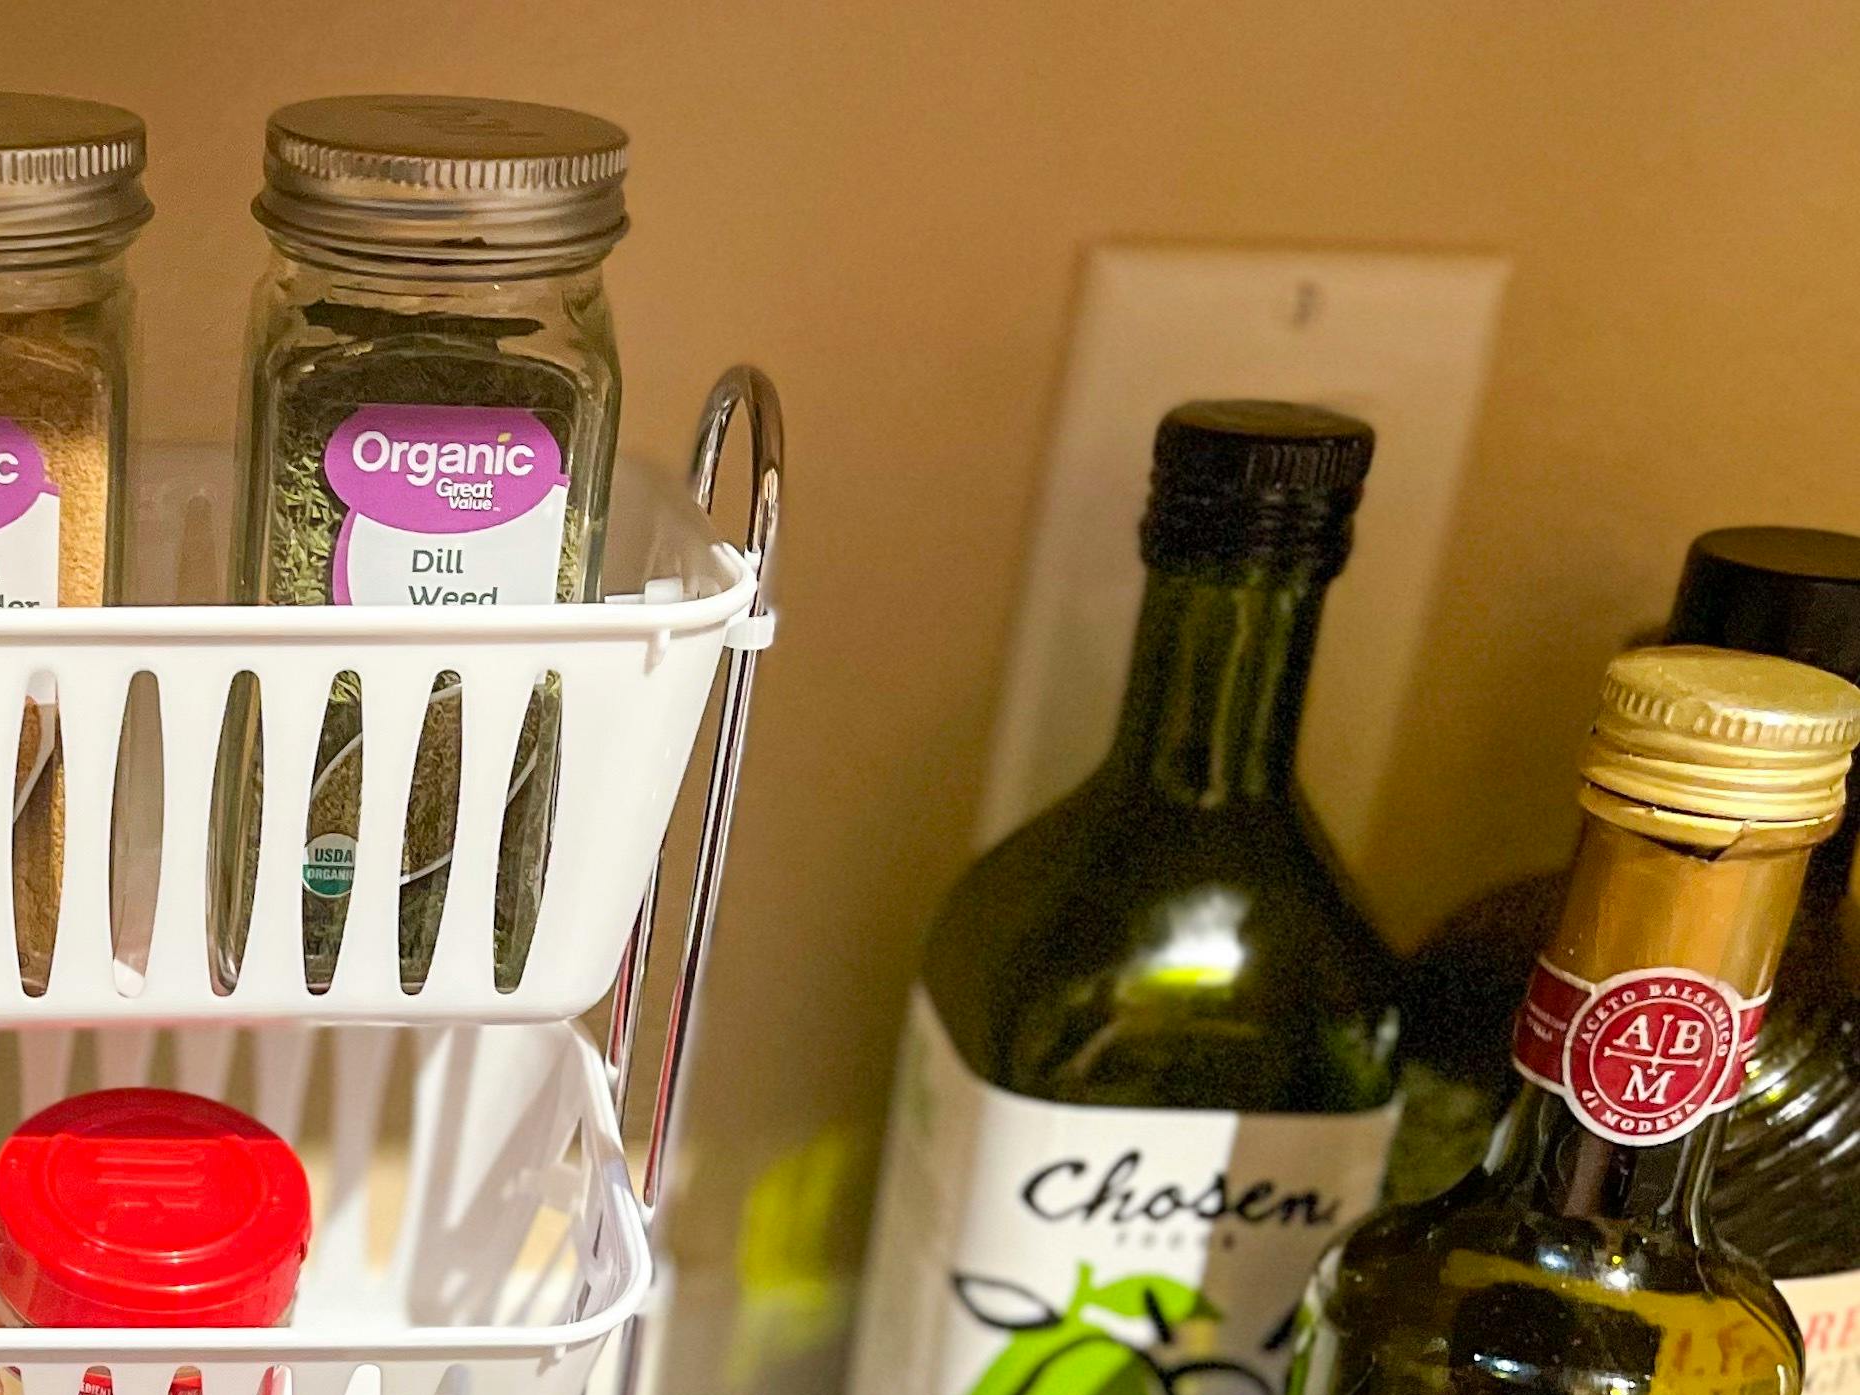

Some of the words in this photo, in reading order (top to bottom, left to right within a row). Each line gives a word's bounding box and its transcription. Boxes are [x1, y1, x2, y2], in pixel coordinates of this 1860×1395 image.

[352, 430, 535, 487] Organic
[436, 477, 494, 499] Great
[449, 496, 492, 511] Value
[411, 549, 464, 574] Dill
[408, 585, 498, 606] Weed
[315, 847, 353, 863] USDA
[1581, 989, 1637, 1045] ACETO
[1612, 1013, 1654, 1051] A
[1668, 1019, 1705, 1056] B
[1621, 1064, 1676, 1105] M
[1021, 1147, 1339, 1225] Chosen
